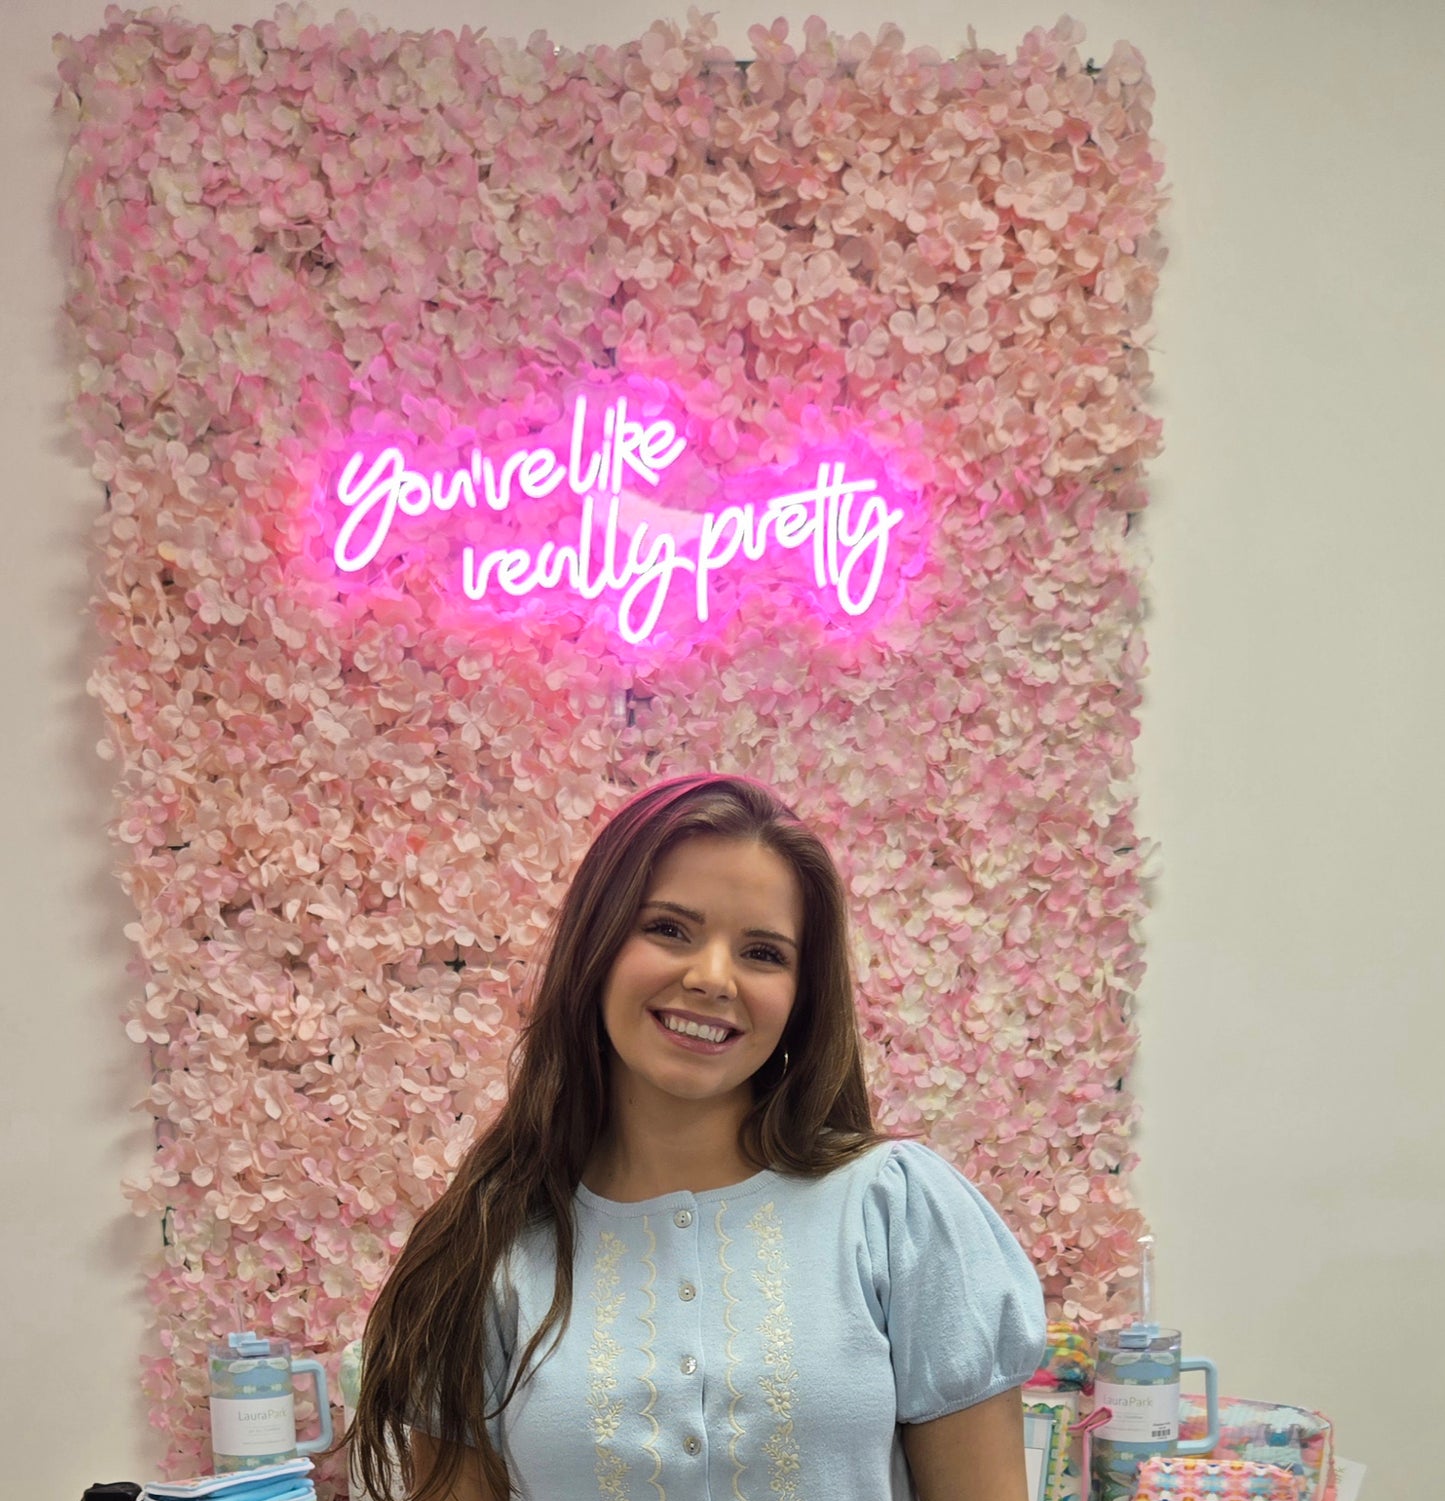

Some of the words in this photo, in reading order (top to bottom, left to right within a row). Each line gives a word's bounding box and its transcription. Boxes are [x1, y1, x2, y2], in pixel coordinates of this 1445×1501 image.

[569, 394, 688, 495] like
[463, 495, 695, 644] really
[696, 461, 904, 622] pretty
